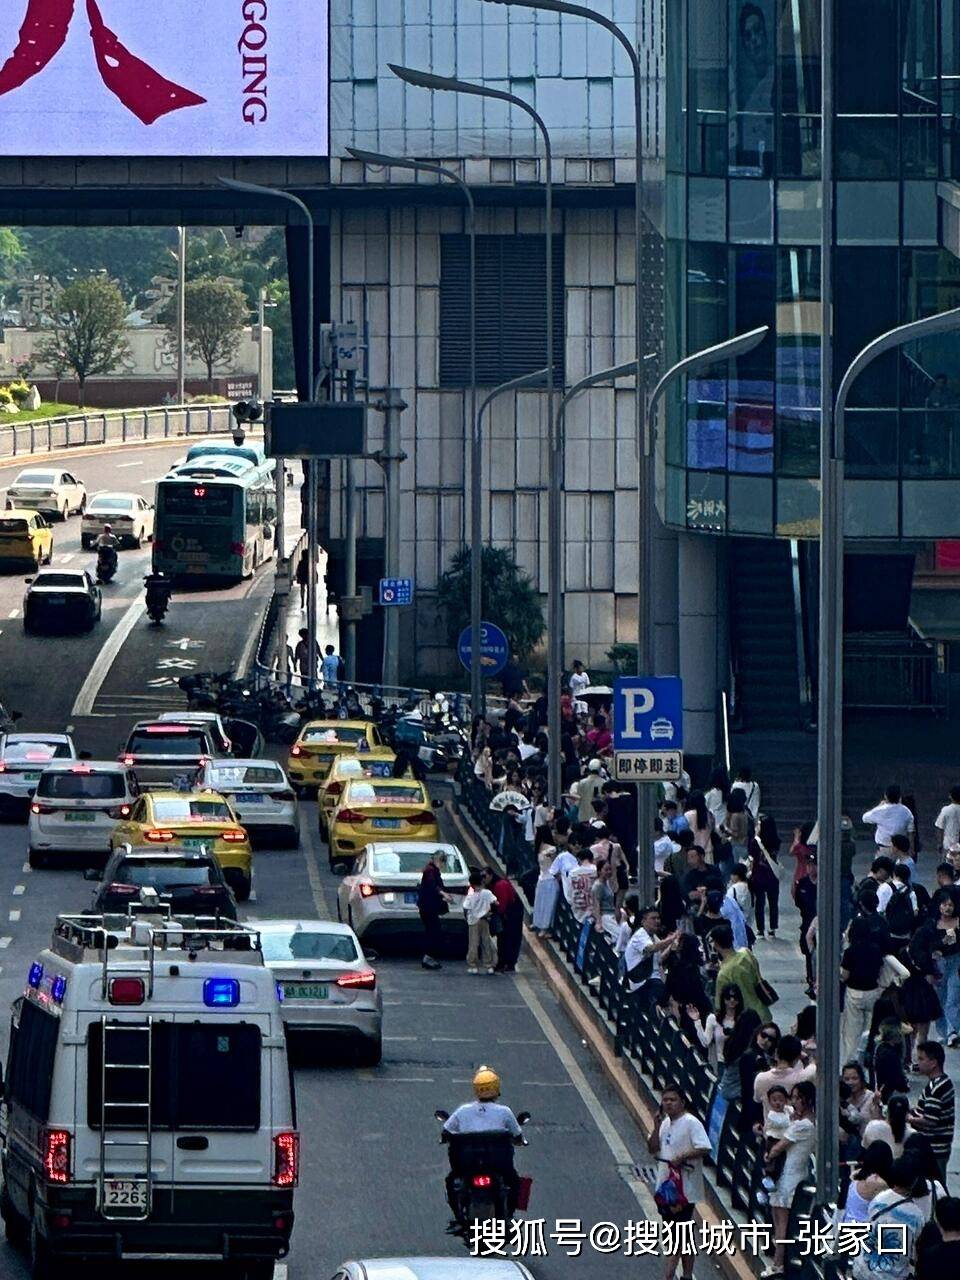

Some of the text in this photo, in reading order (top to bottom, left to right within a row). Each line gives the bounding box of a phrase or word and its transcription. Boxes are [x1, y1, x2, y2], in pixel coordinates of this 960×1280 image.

[621, 688, 654, 738] P
[619, 758, 678, 774] 即停即走
